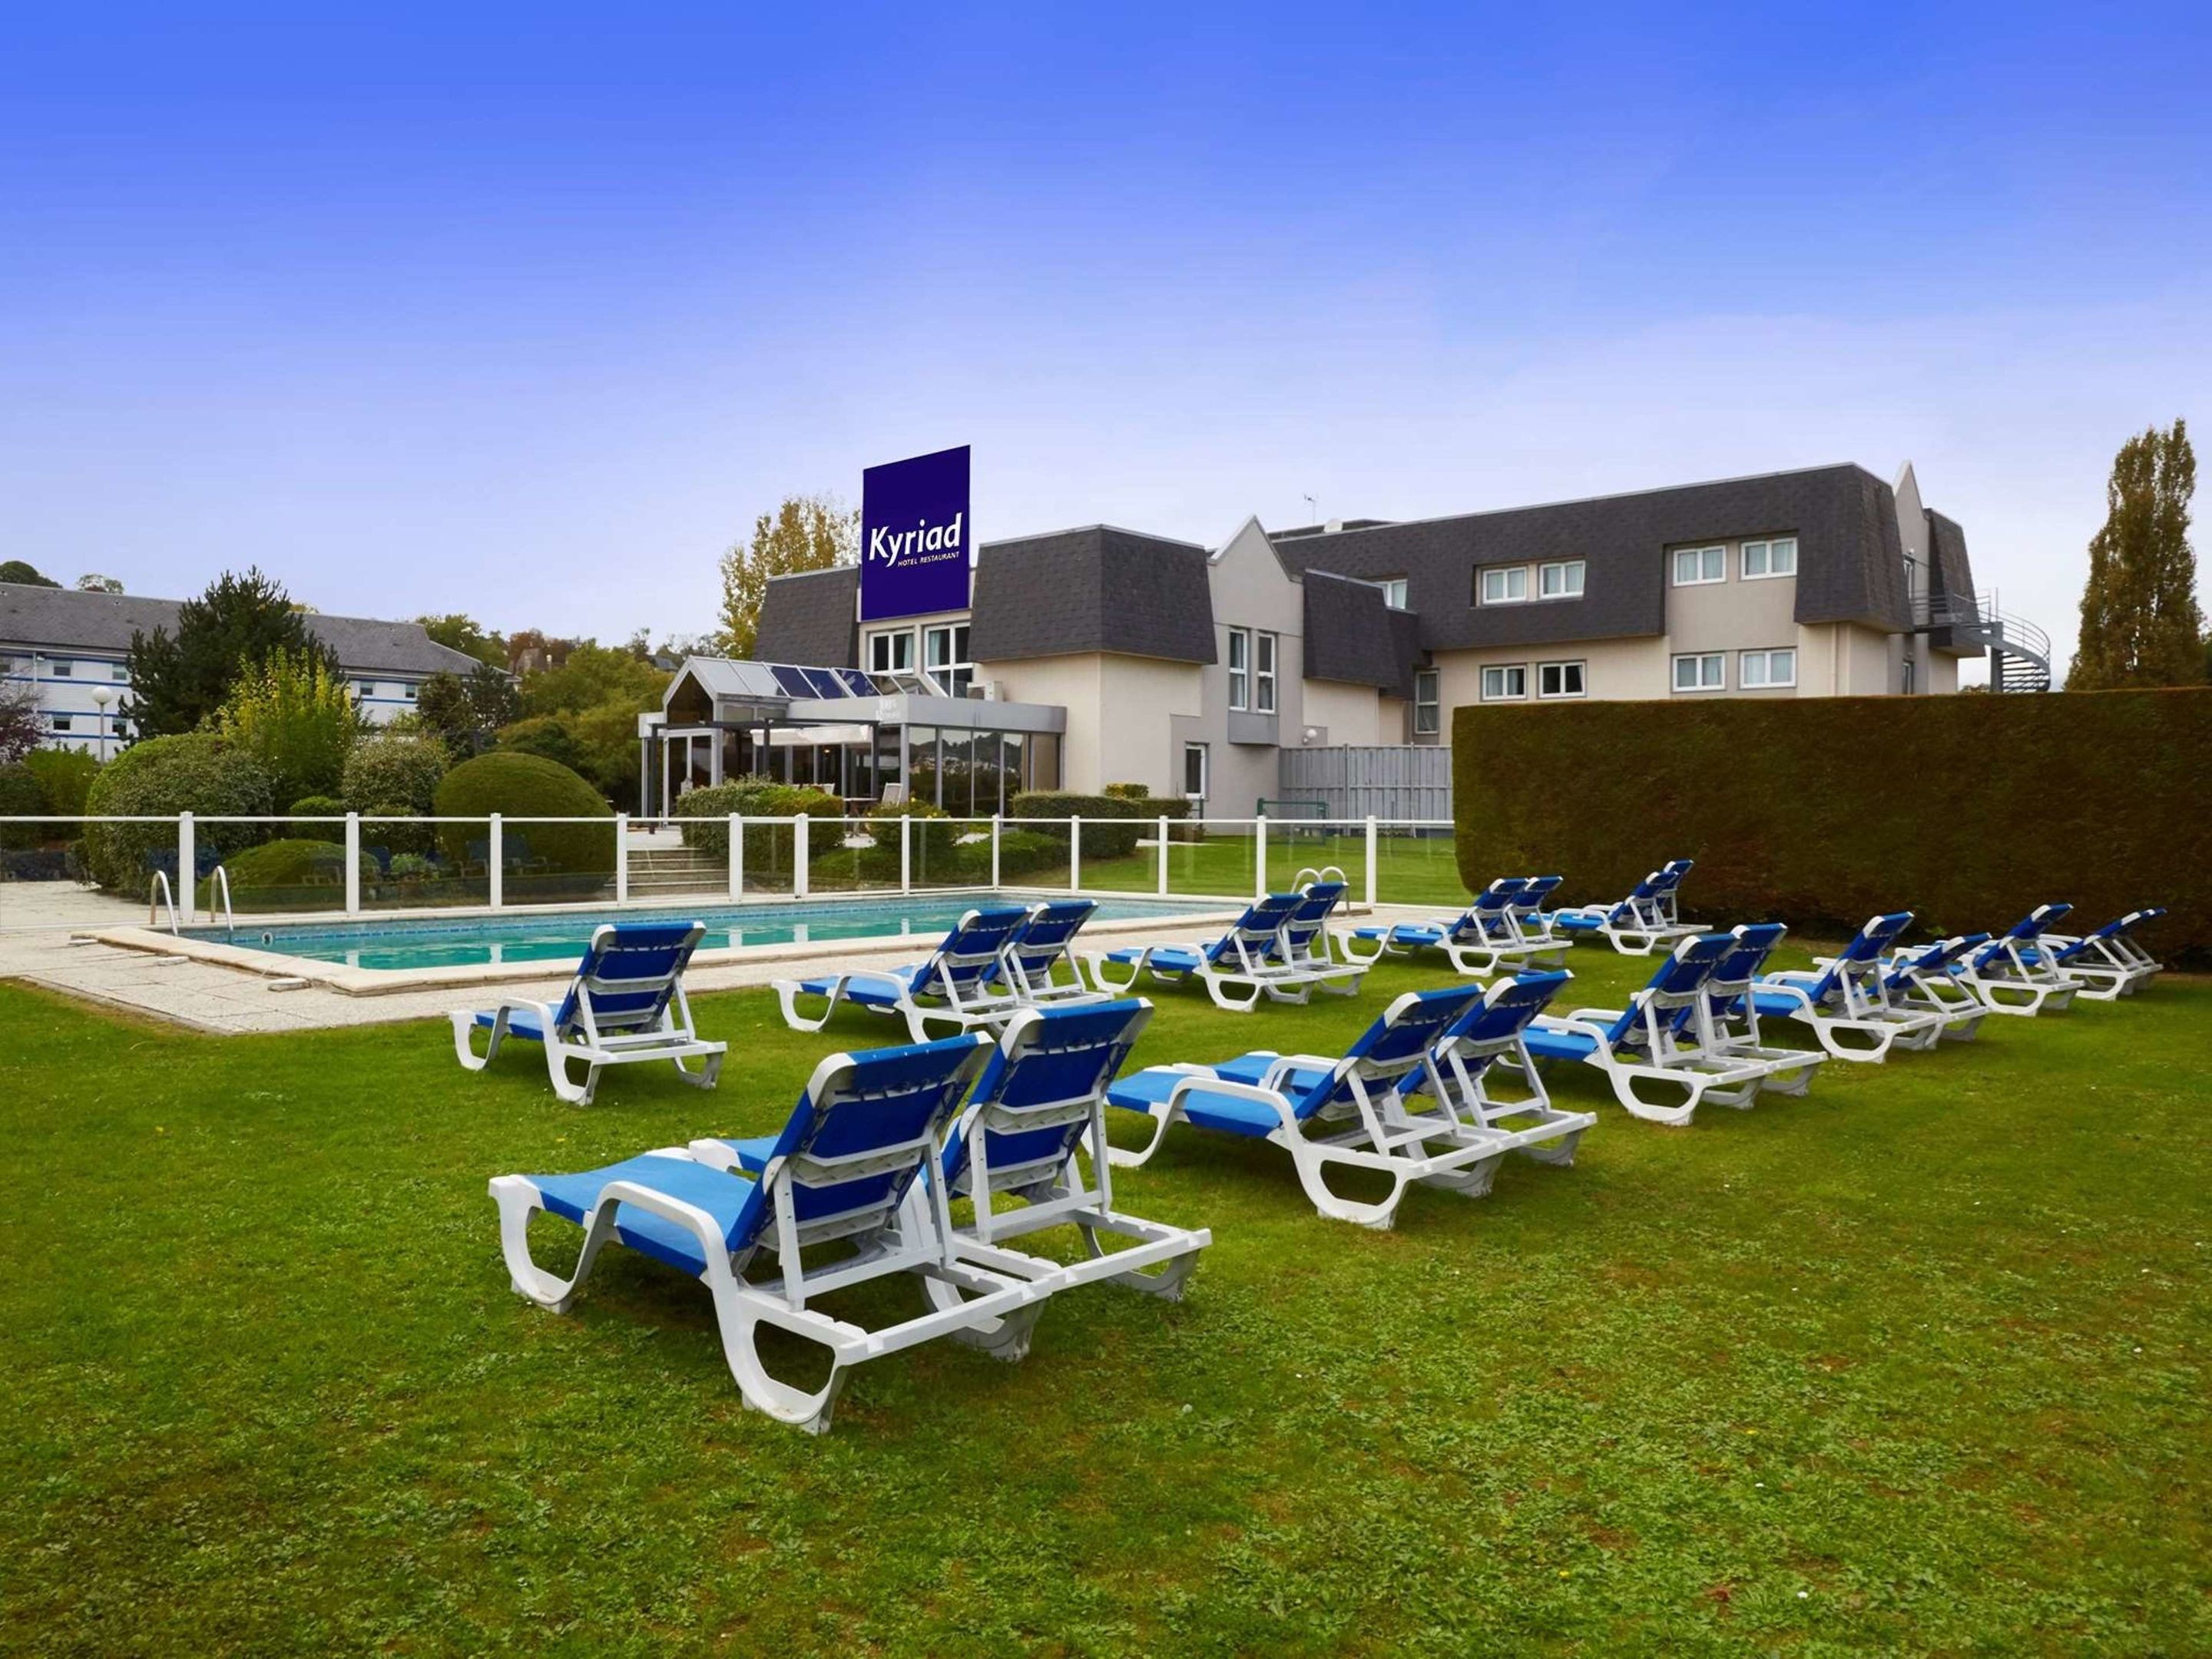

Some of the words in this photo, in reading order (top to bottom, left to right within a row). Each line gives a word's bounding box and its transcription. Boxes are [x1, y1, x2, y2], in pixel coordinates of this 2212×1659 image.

[869, 512, 962, 568] Kyriad
[898, 558, 918, 567] HOTEL
[919, 551, 959, 564] RESTAURANT
